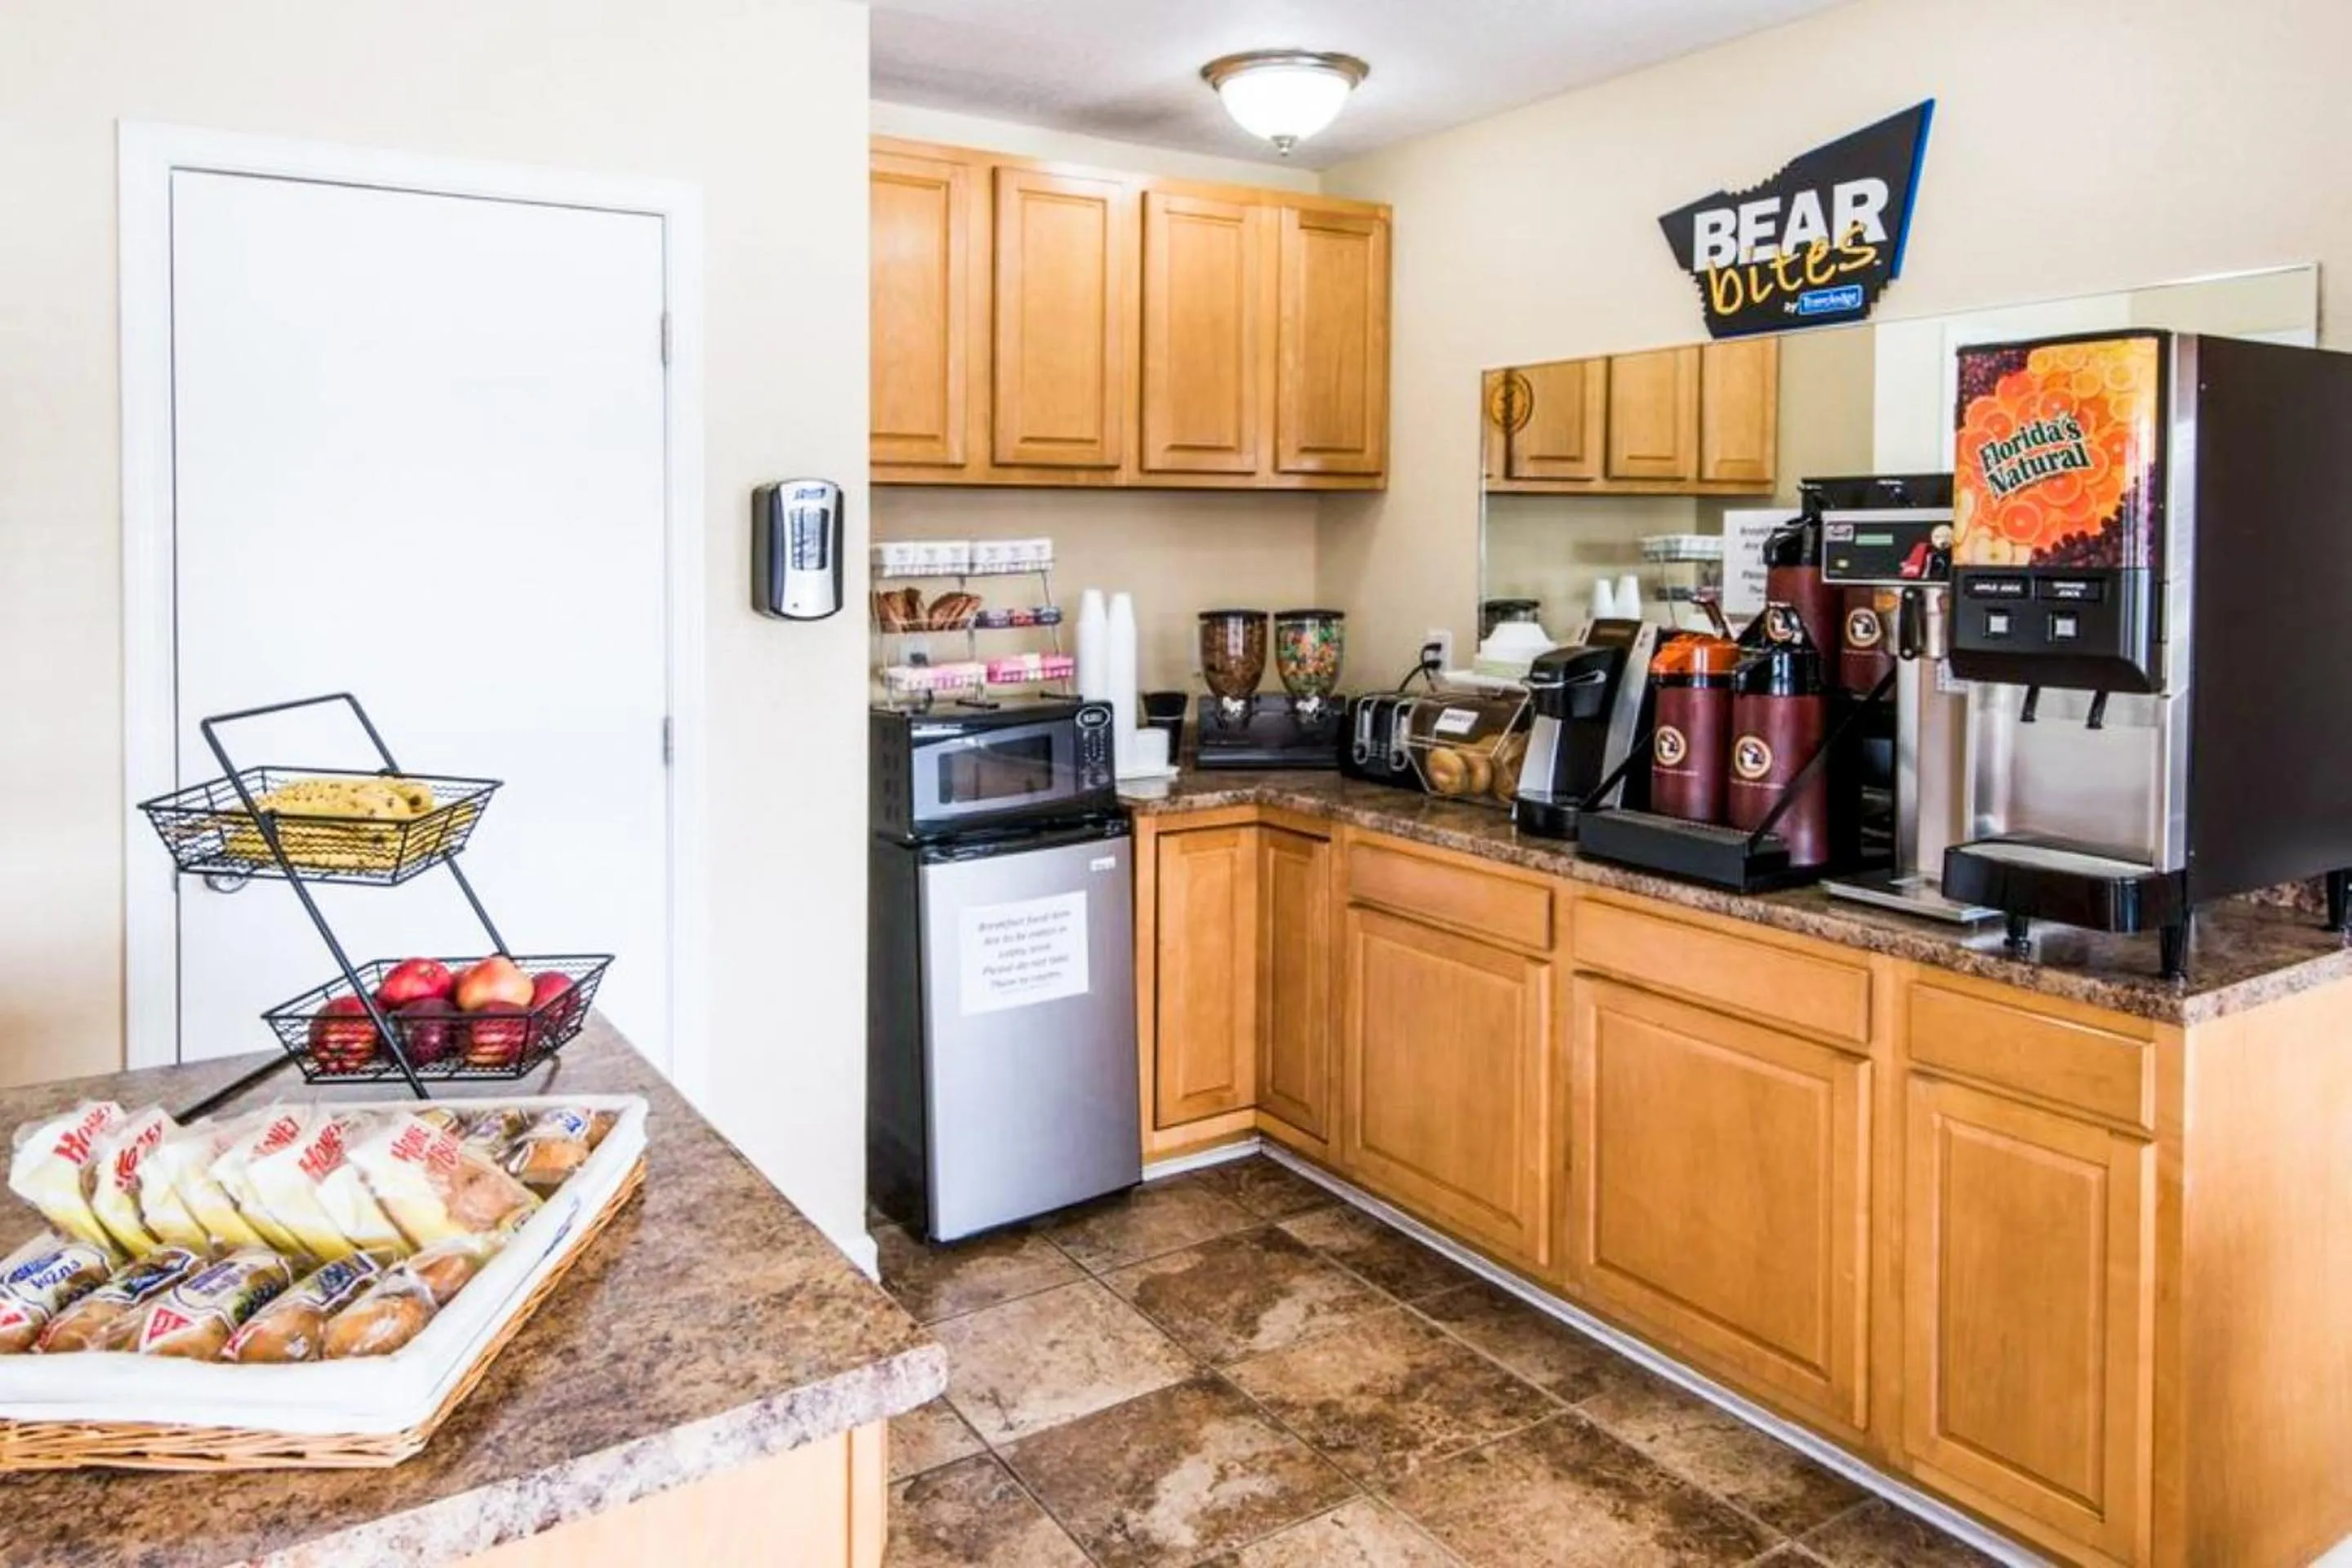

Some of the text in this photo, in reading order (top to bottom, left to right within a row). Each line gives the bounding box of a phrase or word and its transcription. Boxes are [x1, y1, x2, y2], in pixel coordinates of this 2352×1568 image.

[1693, 177, 1889, 273] BEAR
[1707, 222, 1878, 315] bites
[1980, 419, 2082, 472] Florida's
[1988, 442, 2091, 500] Natural
